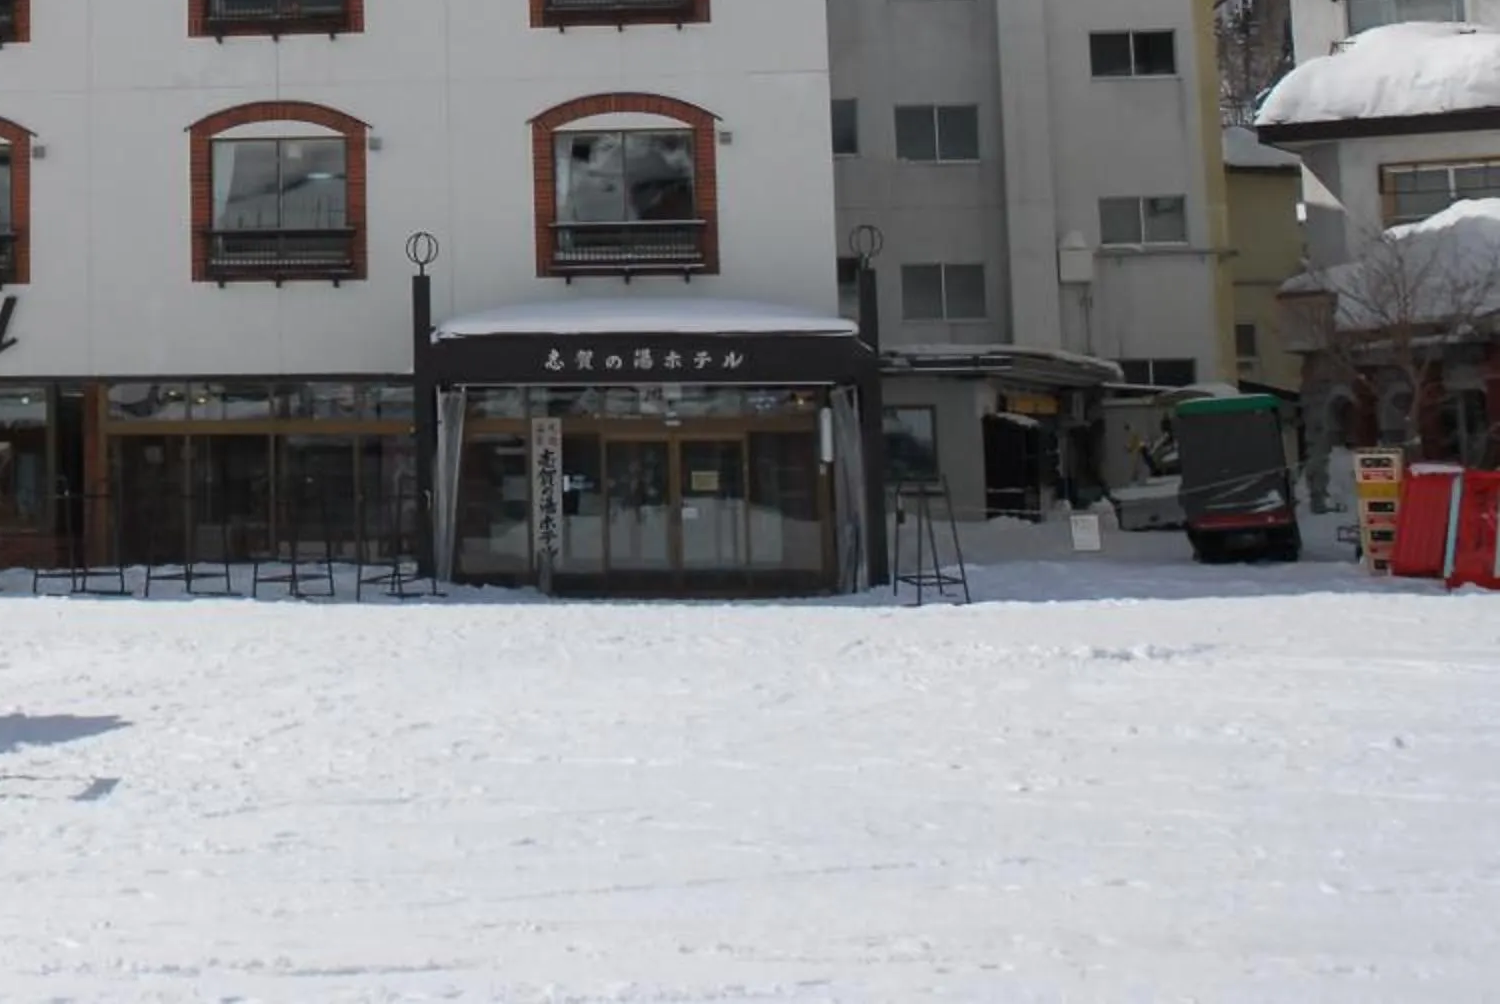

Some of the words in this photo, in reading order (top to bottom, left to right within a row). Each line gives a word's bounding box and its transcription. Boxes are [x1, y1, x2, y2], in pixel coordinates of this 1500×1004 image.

[544, 348, 744, 371] 志賀の湯ホテル
